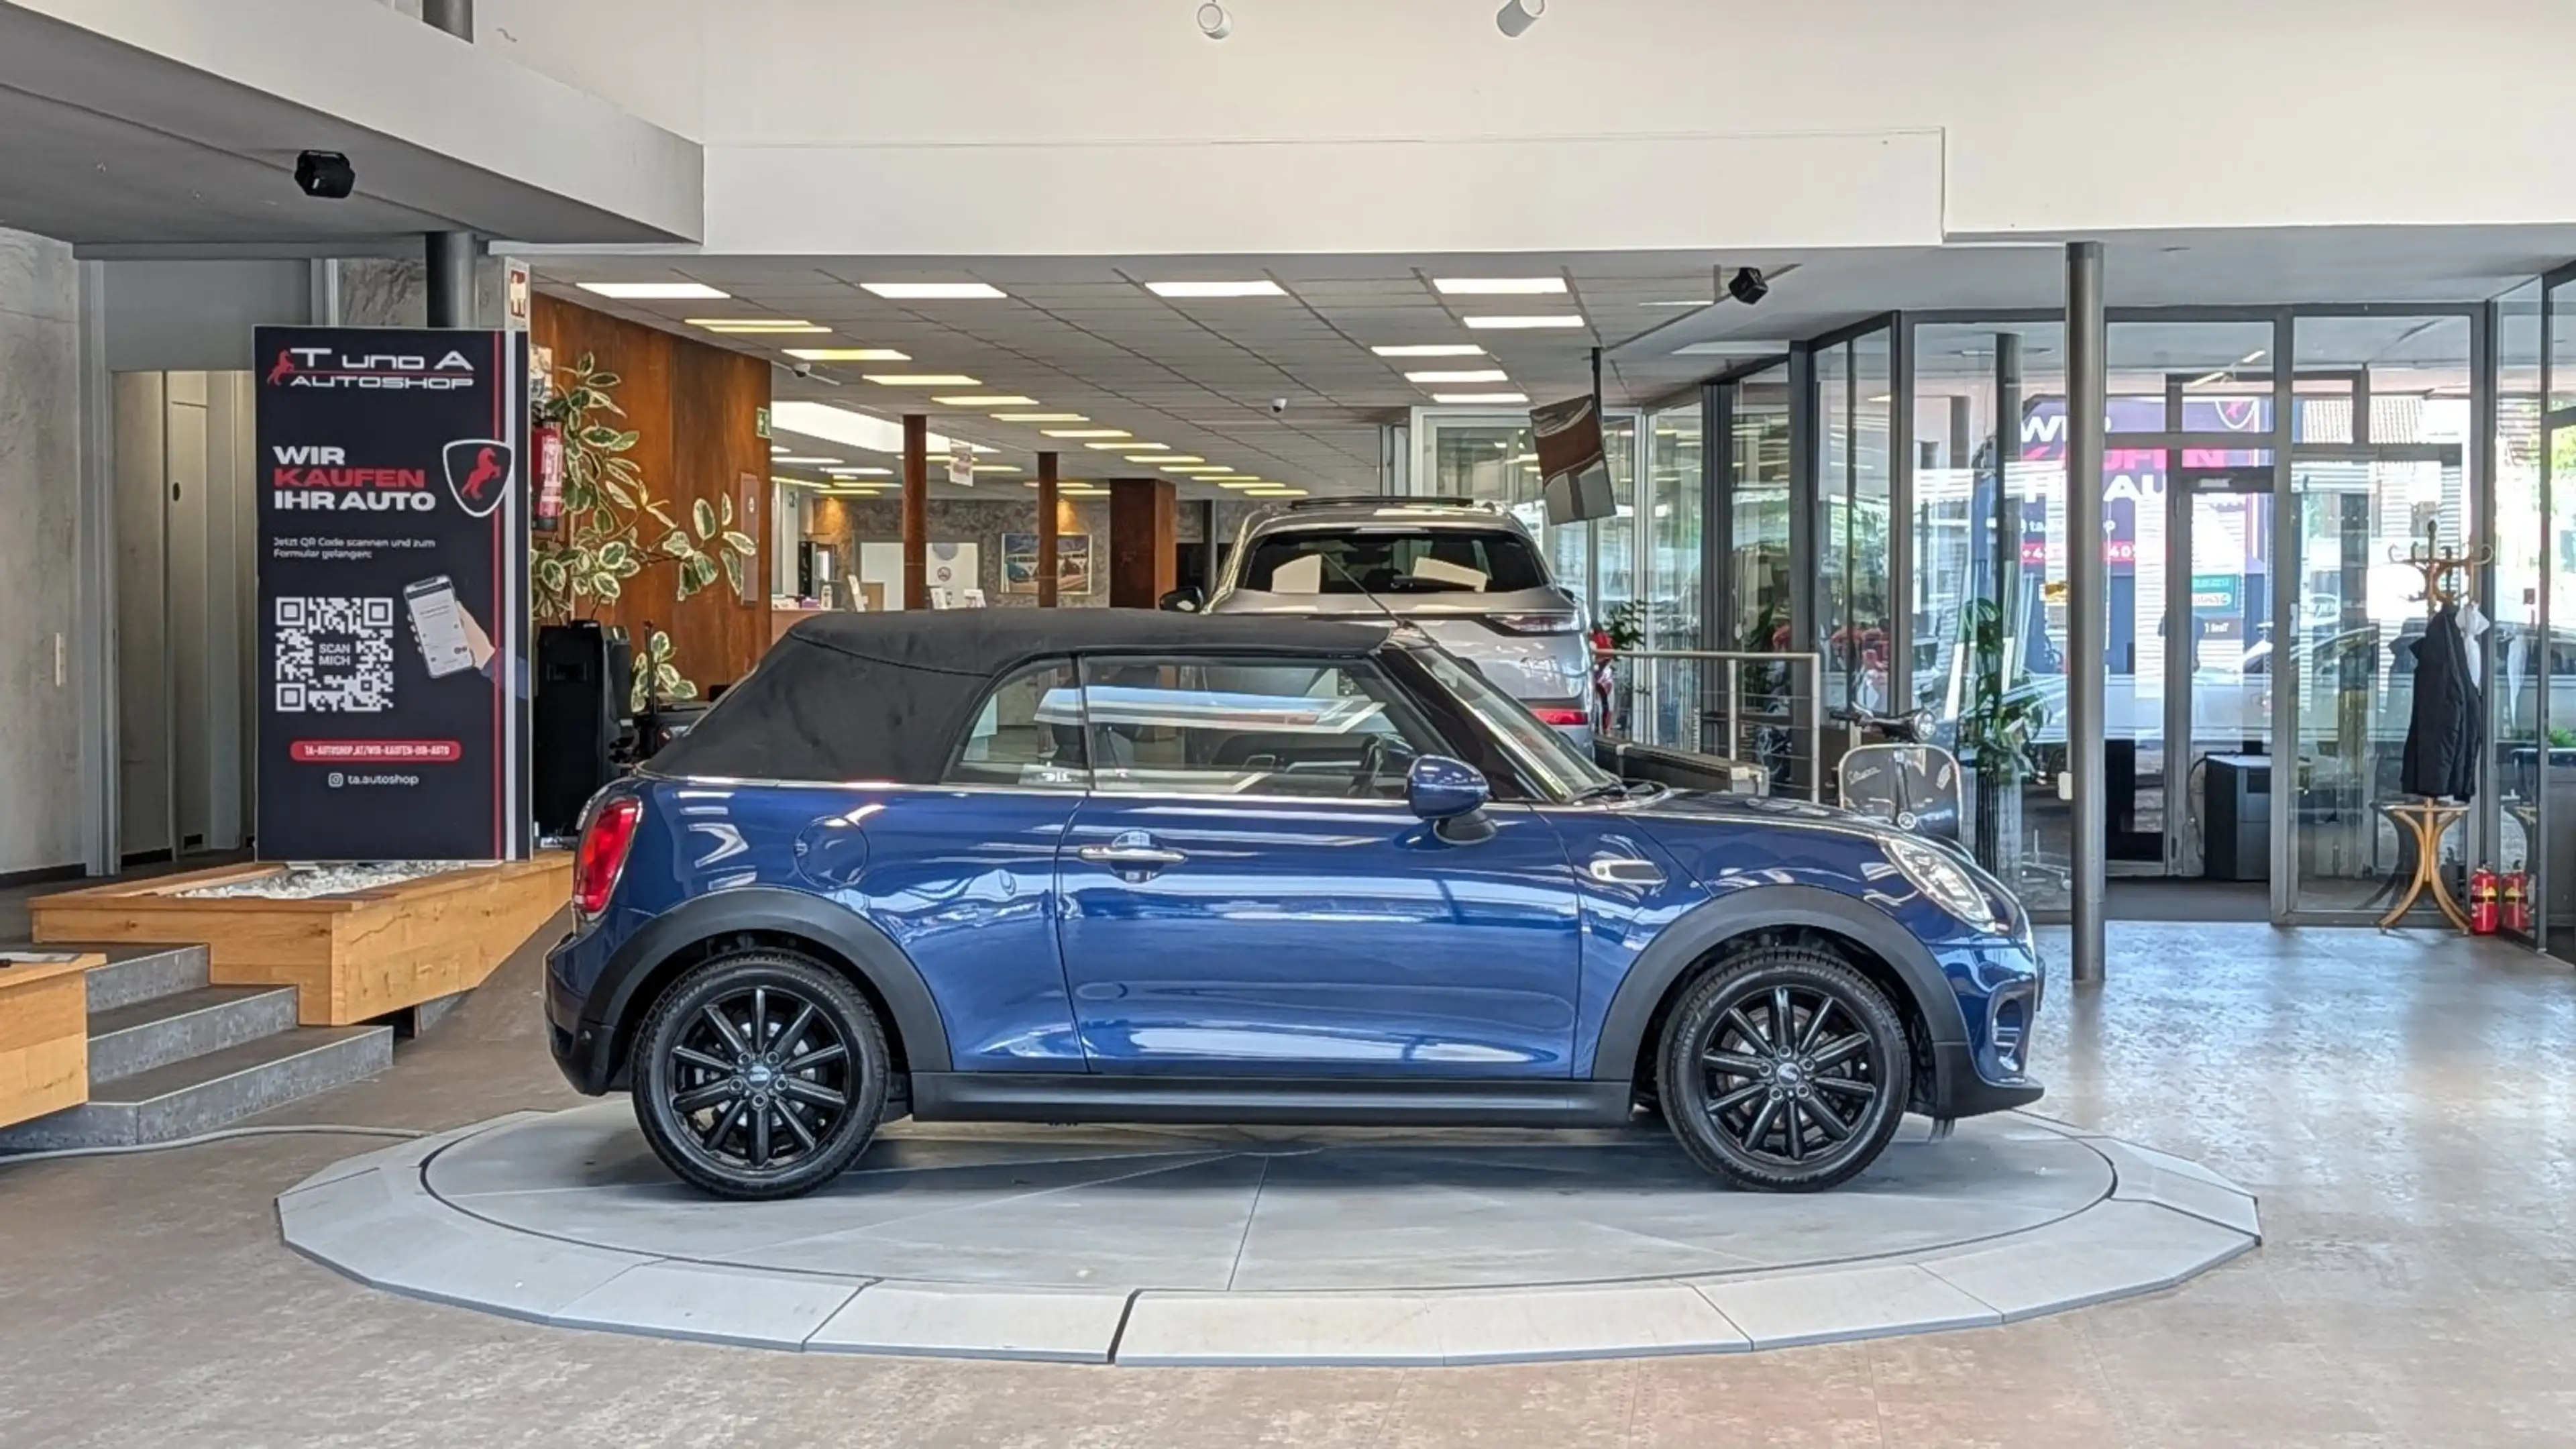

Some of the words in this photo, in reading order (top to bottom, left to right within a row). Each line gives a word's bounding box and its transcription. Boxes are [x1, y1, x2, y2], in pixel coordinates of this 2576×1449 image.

[290, 347, 332, 368] T
[434, 350, 475, 371] A
[290, 375, 474, 390] AUTOSHOP
[273, 445, 345, 465] WIR
[274, 468, 425, 487] KAUFEN
[274, 490, 335, 510] IHR
[339, 491, 436, 511] AUTO
[274, 537, 299, 547] Jetzt
[300, 537, 317, 547] QR
[318, 537, 345, 547] Code
[346, 539, 389, 547] scannen
[391, 539, 411, 548] und
[413, 539, 436, 548] zum
[274, 548, 320, 557] Formular
[321, 549, 373, 560] gelangen:
[319, 643, 351, 654] SCAN
[319, 655, 351, 666] MICH
[347, 774, 419, 786] ta.autoshop
